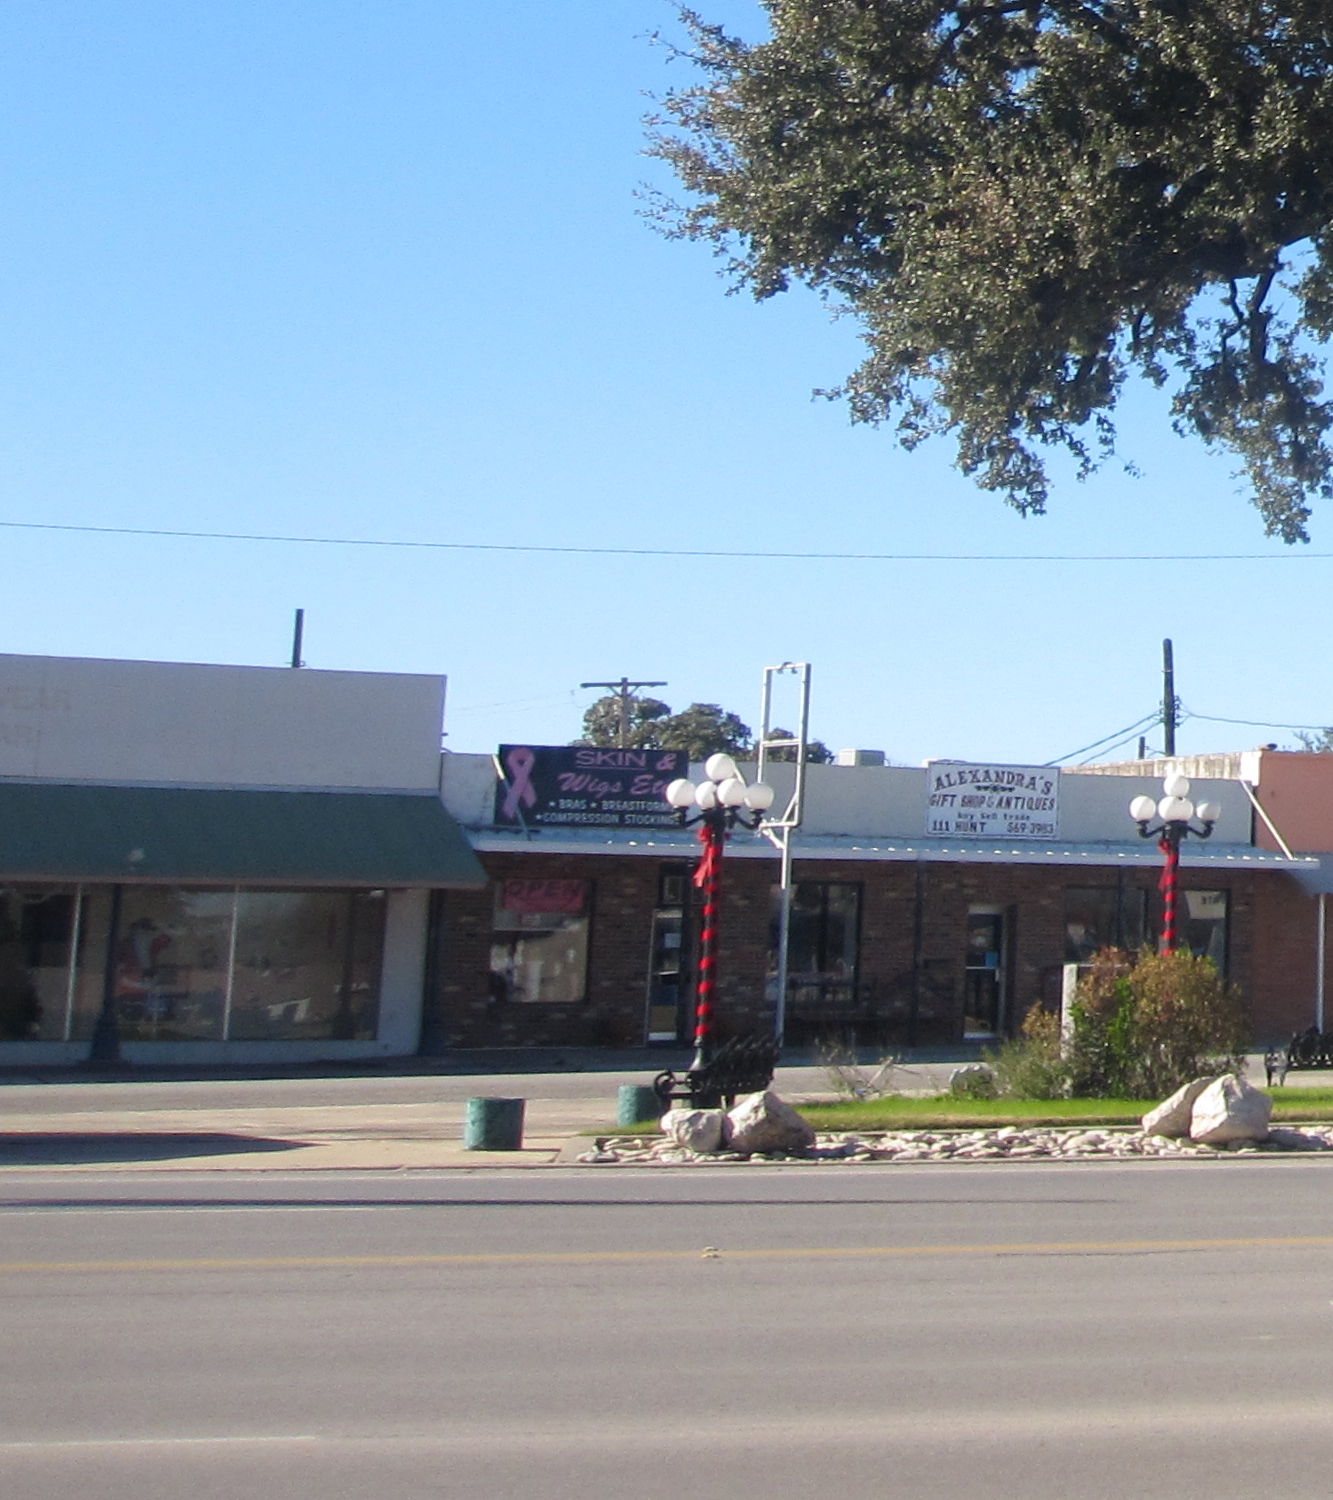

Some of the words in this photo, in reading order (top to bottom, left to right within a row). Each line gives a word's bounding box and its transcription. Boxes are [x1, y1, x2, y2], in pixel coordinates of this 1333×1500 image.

[575, 750, 647, 767] SKIN
[656, 752, 677, 771] &
[557, 772, 622, 799] Wigs
[934, 769, 1053, 795] ALEXANDRA'S
[559, 799, 588, 810] BRAS
[929, 794, 957, 808] GIFT
[961, 795, 986, 809] SHOP
[996, 796, 1055, 812] ANTIQUES
[543, 812, 620, 825] COMPRESSION
[954, 821, 987, 833] HUNT
[507, 880, 582, 897] OPEN
